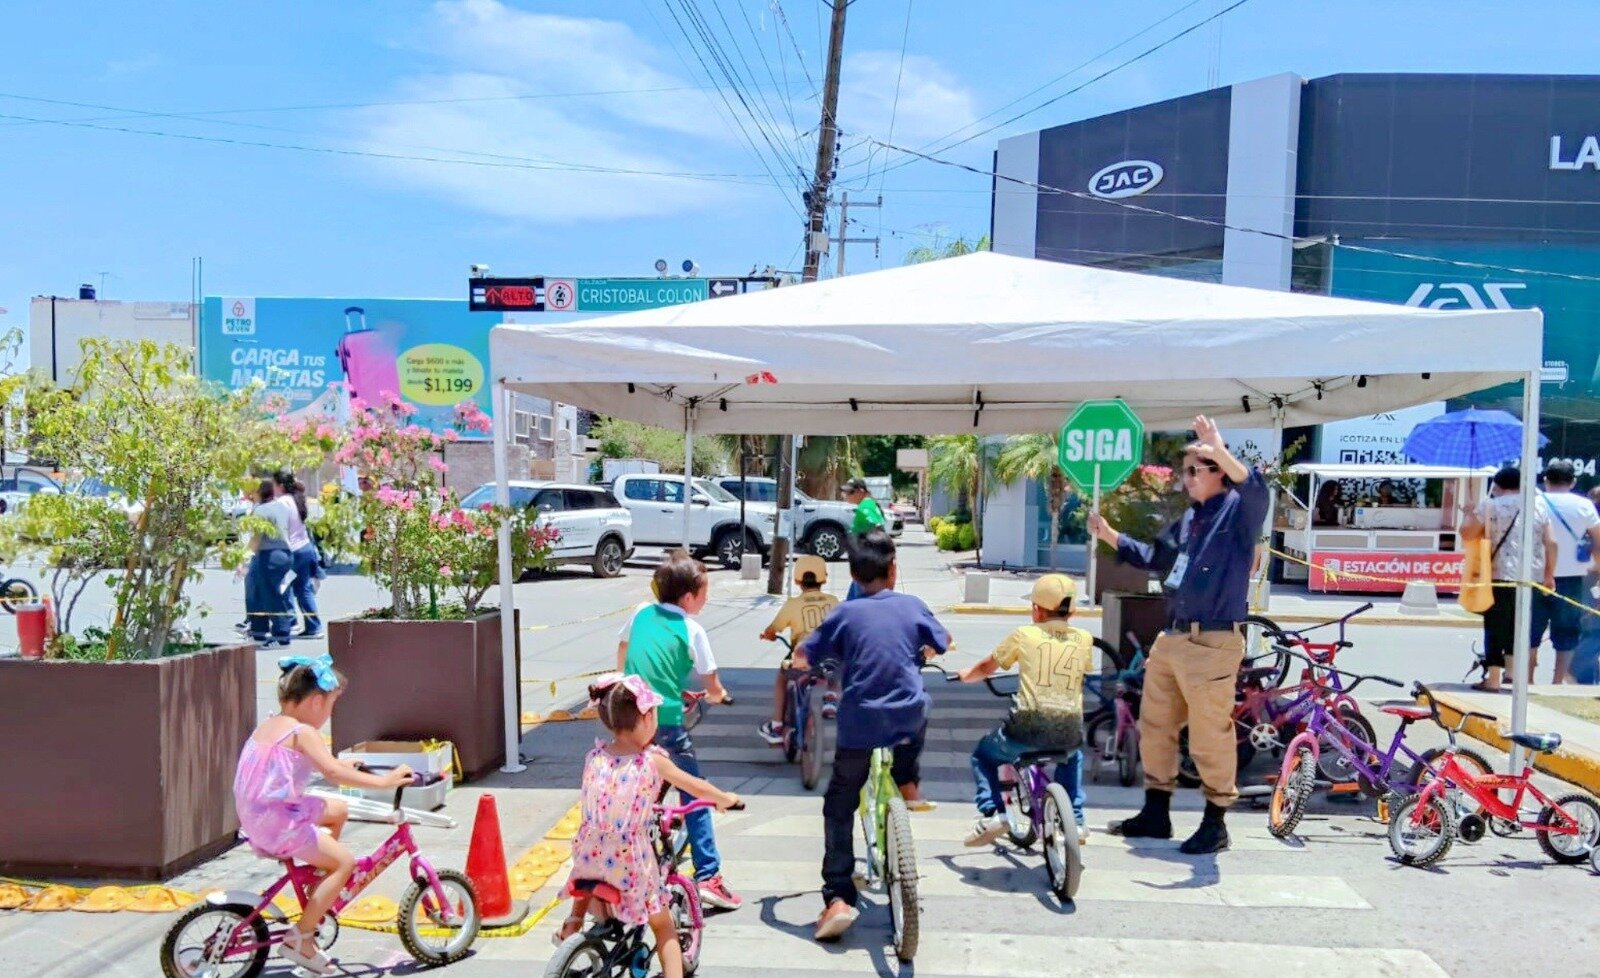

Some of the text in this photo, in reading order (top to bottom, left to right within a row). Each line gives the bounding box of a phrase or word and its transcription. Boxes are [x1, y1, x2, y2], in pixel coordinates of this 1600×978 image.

[1099, 168, 1149, 190] JAC
[502, 288, 534, 302] ALTO
[580, 287, 702, 304] CRISTOBAL COLON
[225, 318, 252, 326] PETRO
[227, 325, 251, 333] SEVEN
[230, 348, 326, 367] CARGA TUS
[424, 377, 473, 394] $1,199
[1065, 428, 1132, 462] SIGA
[1343, 557, 1411, 574] ESTACIÓN
[1413, 562, 1430, 573] DE
[1036, 641, 1081, 691] 14
